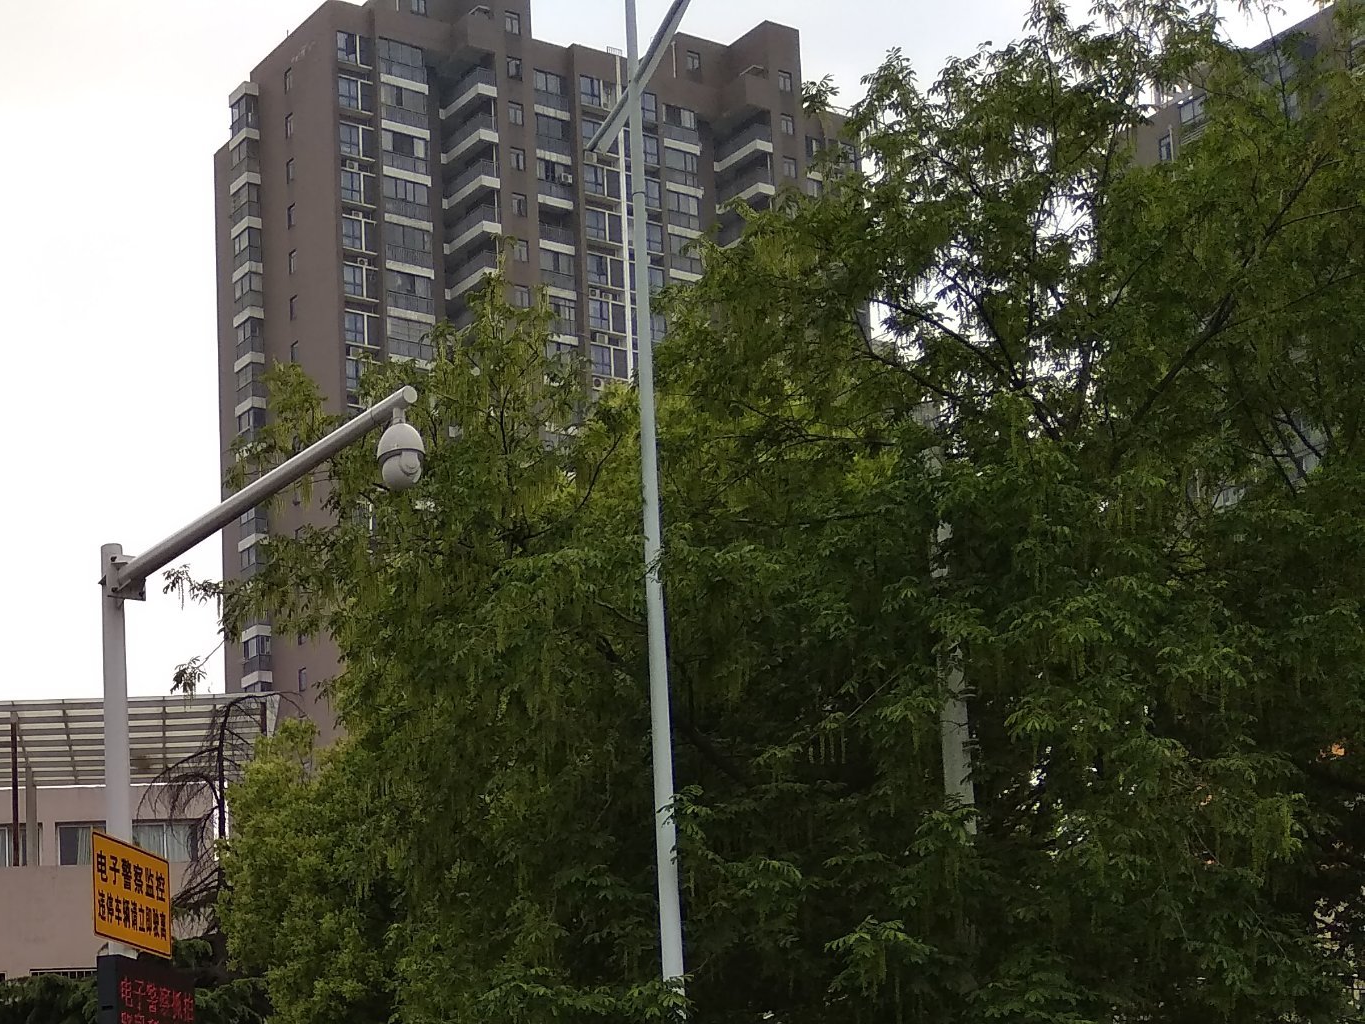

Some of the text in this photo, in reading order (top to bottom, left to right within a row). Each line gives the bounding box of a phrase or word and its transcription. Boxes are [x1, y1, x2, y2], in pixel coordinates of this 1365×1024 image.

[96, 850, 166, 903] 电子警察监控
